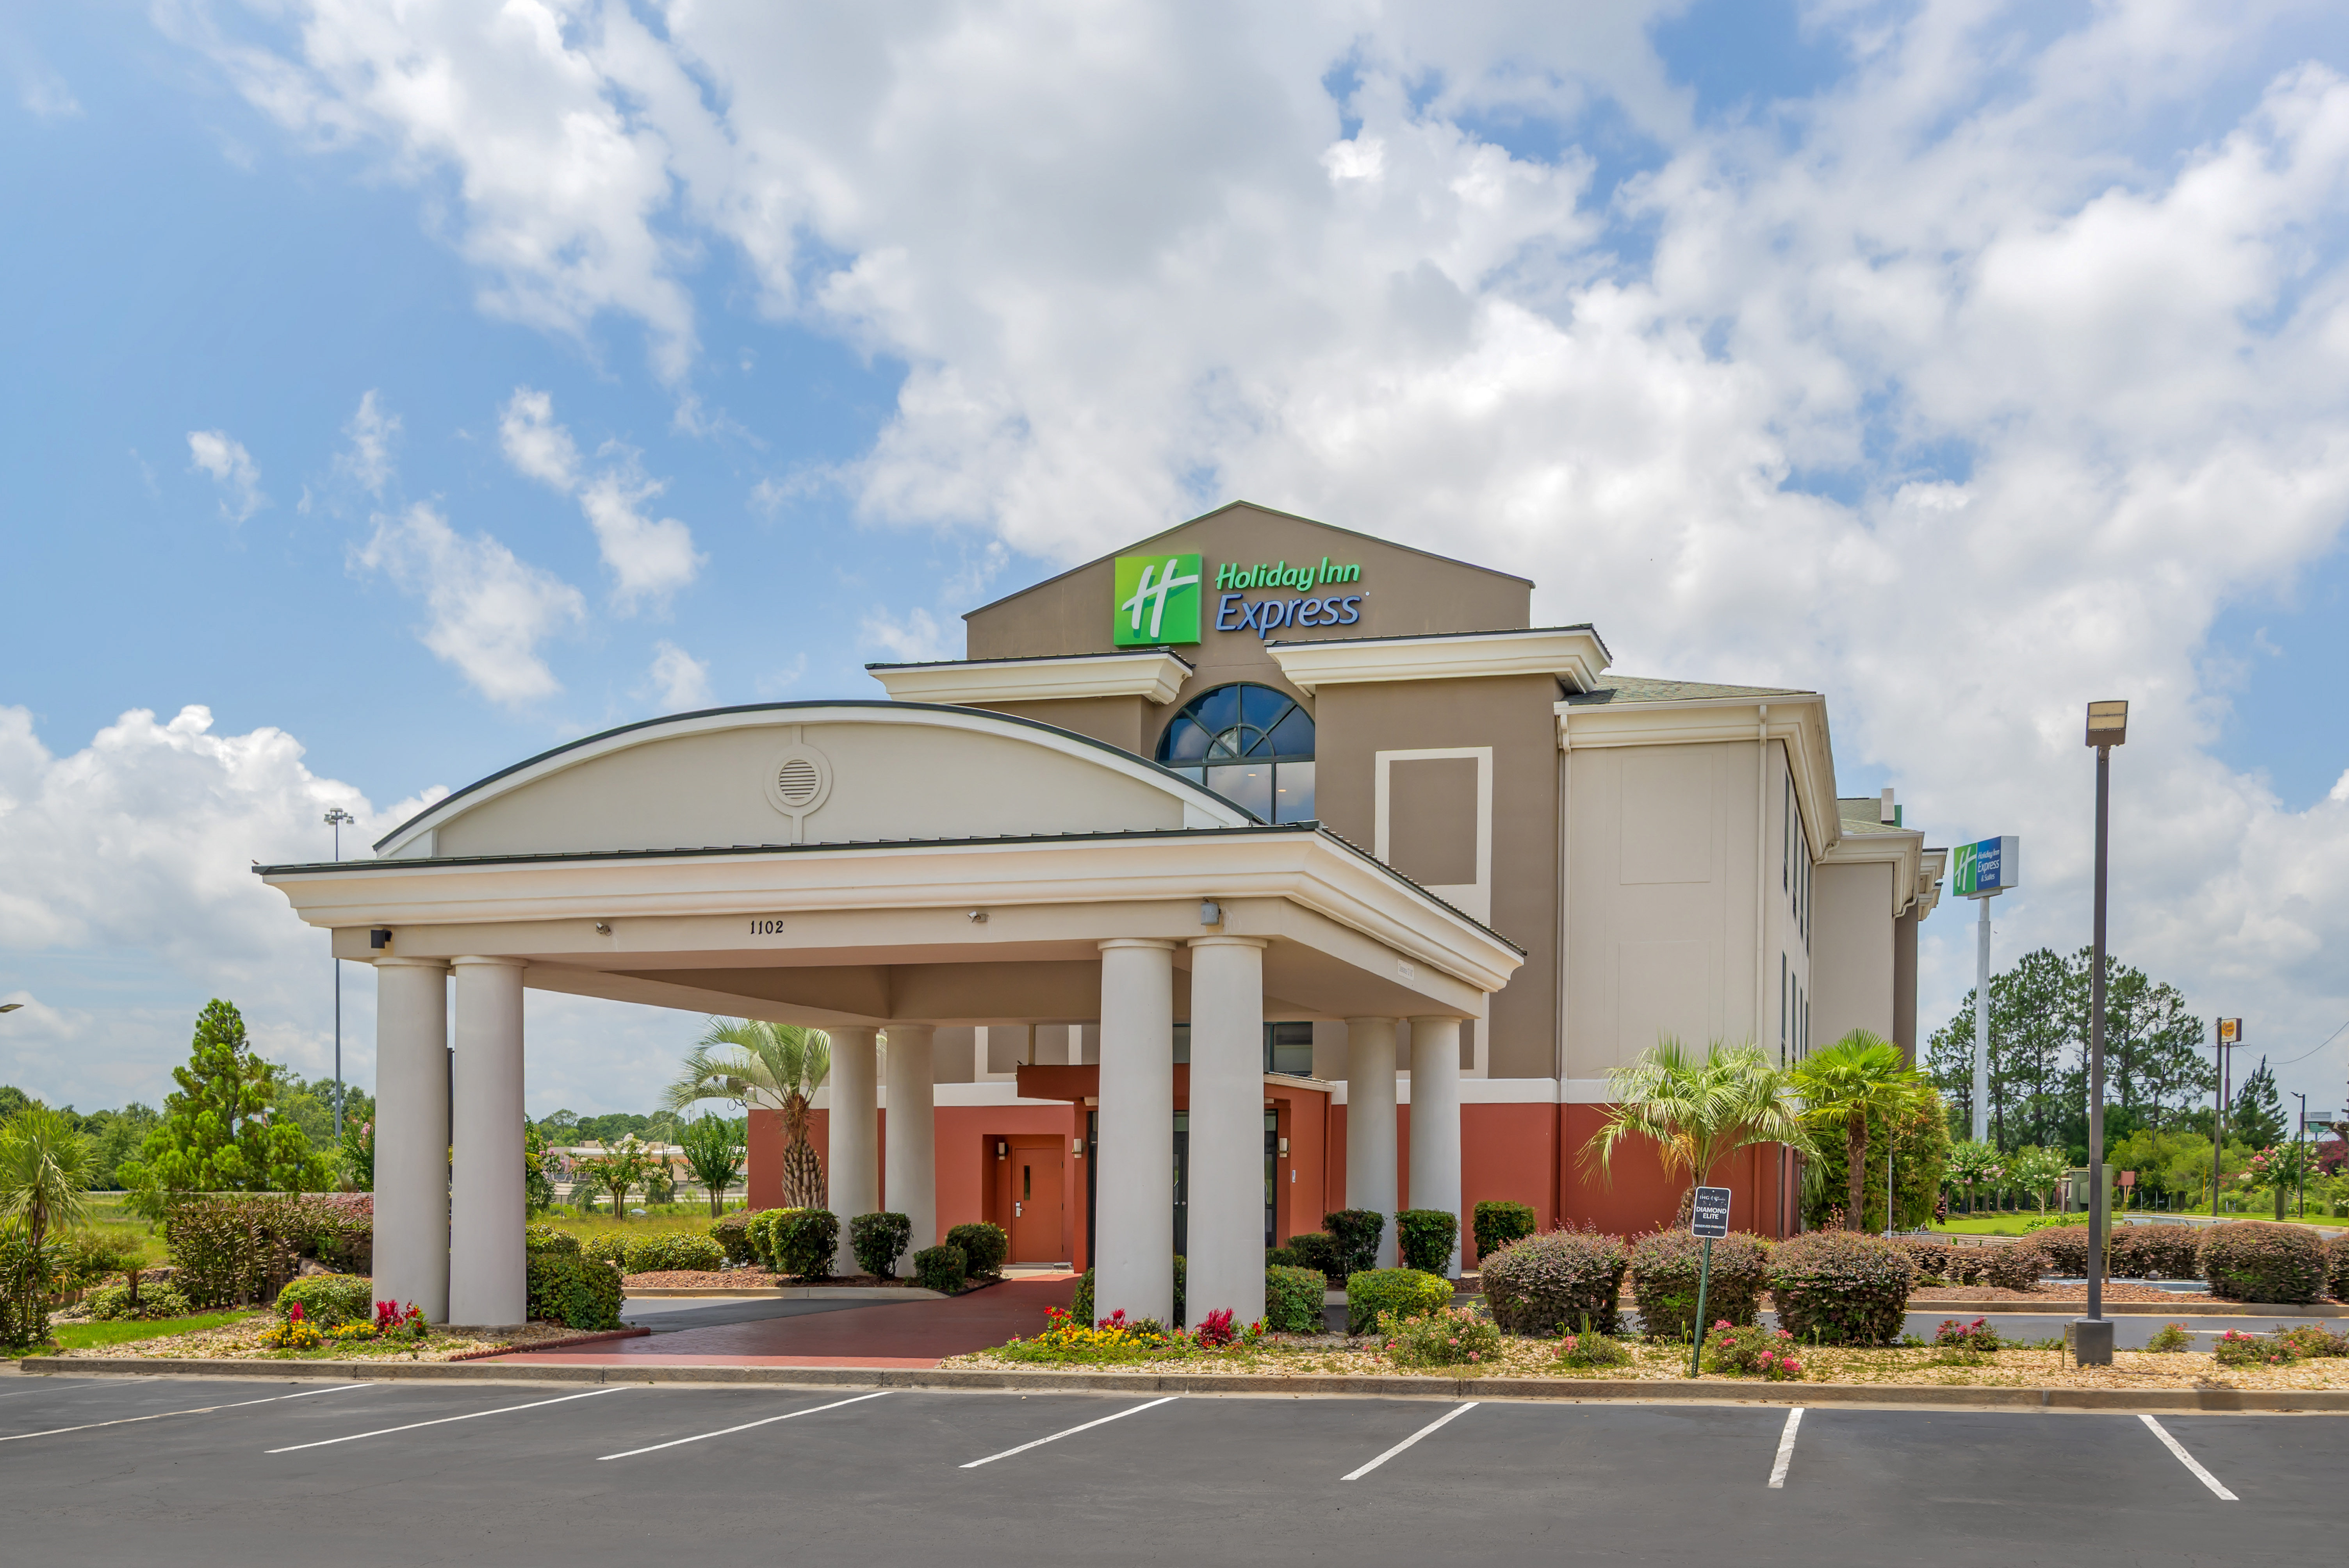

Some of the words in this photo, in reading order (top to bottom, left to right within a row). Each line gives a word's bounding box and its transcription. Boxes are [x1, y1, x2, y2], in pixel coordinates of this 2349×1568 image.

[1215, 560, 1317, 592] Holiday
[1319, 556, 1361, 584] Inn
[1215, 593, 1362, 640] Express
[1978, 850, 1993, 859] Holiday
[1977, 859, 2000, 874] Express
[1984, 873, 1995, 882] Suites
[750, 920, 783, 935] 1102
[1696, 1206, 1727, 1214] DIAMOND
